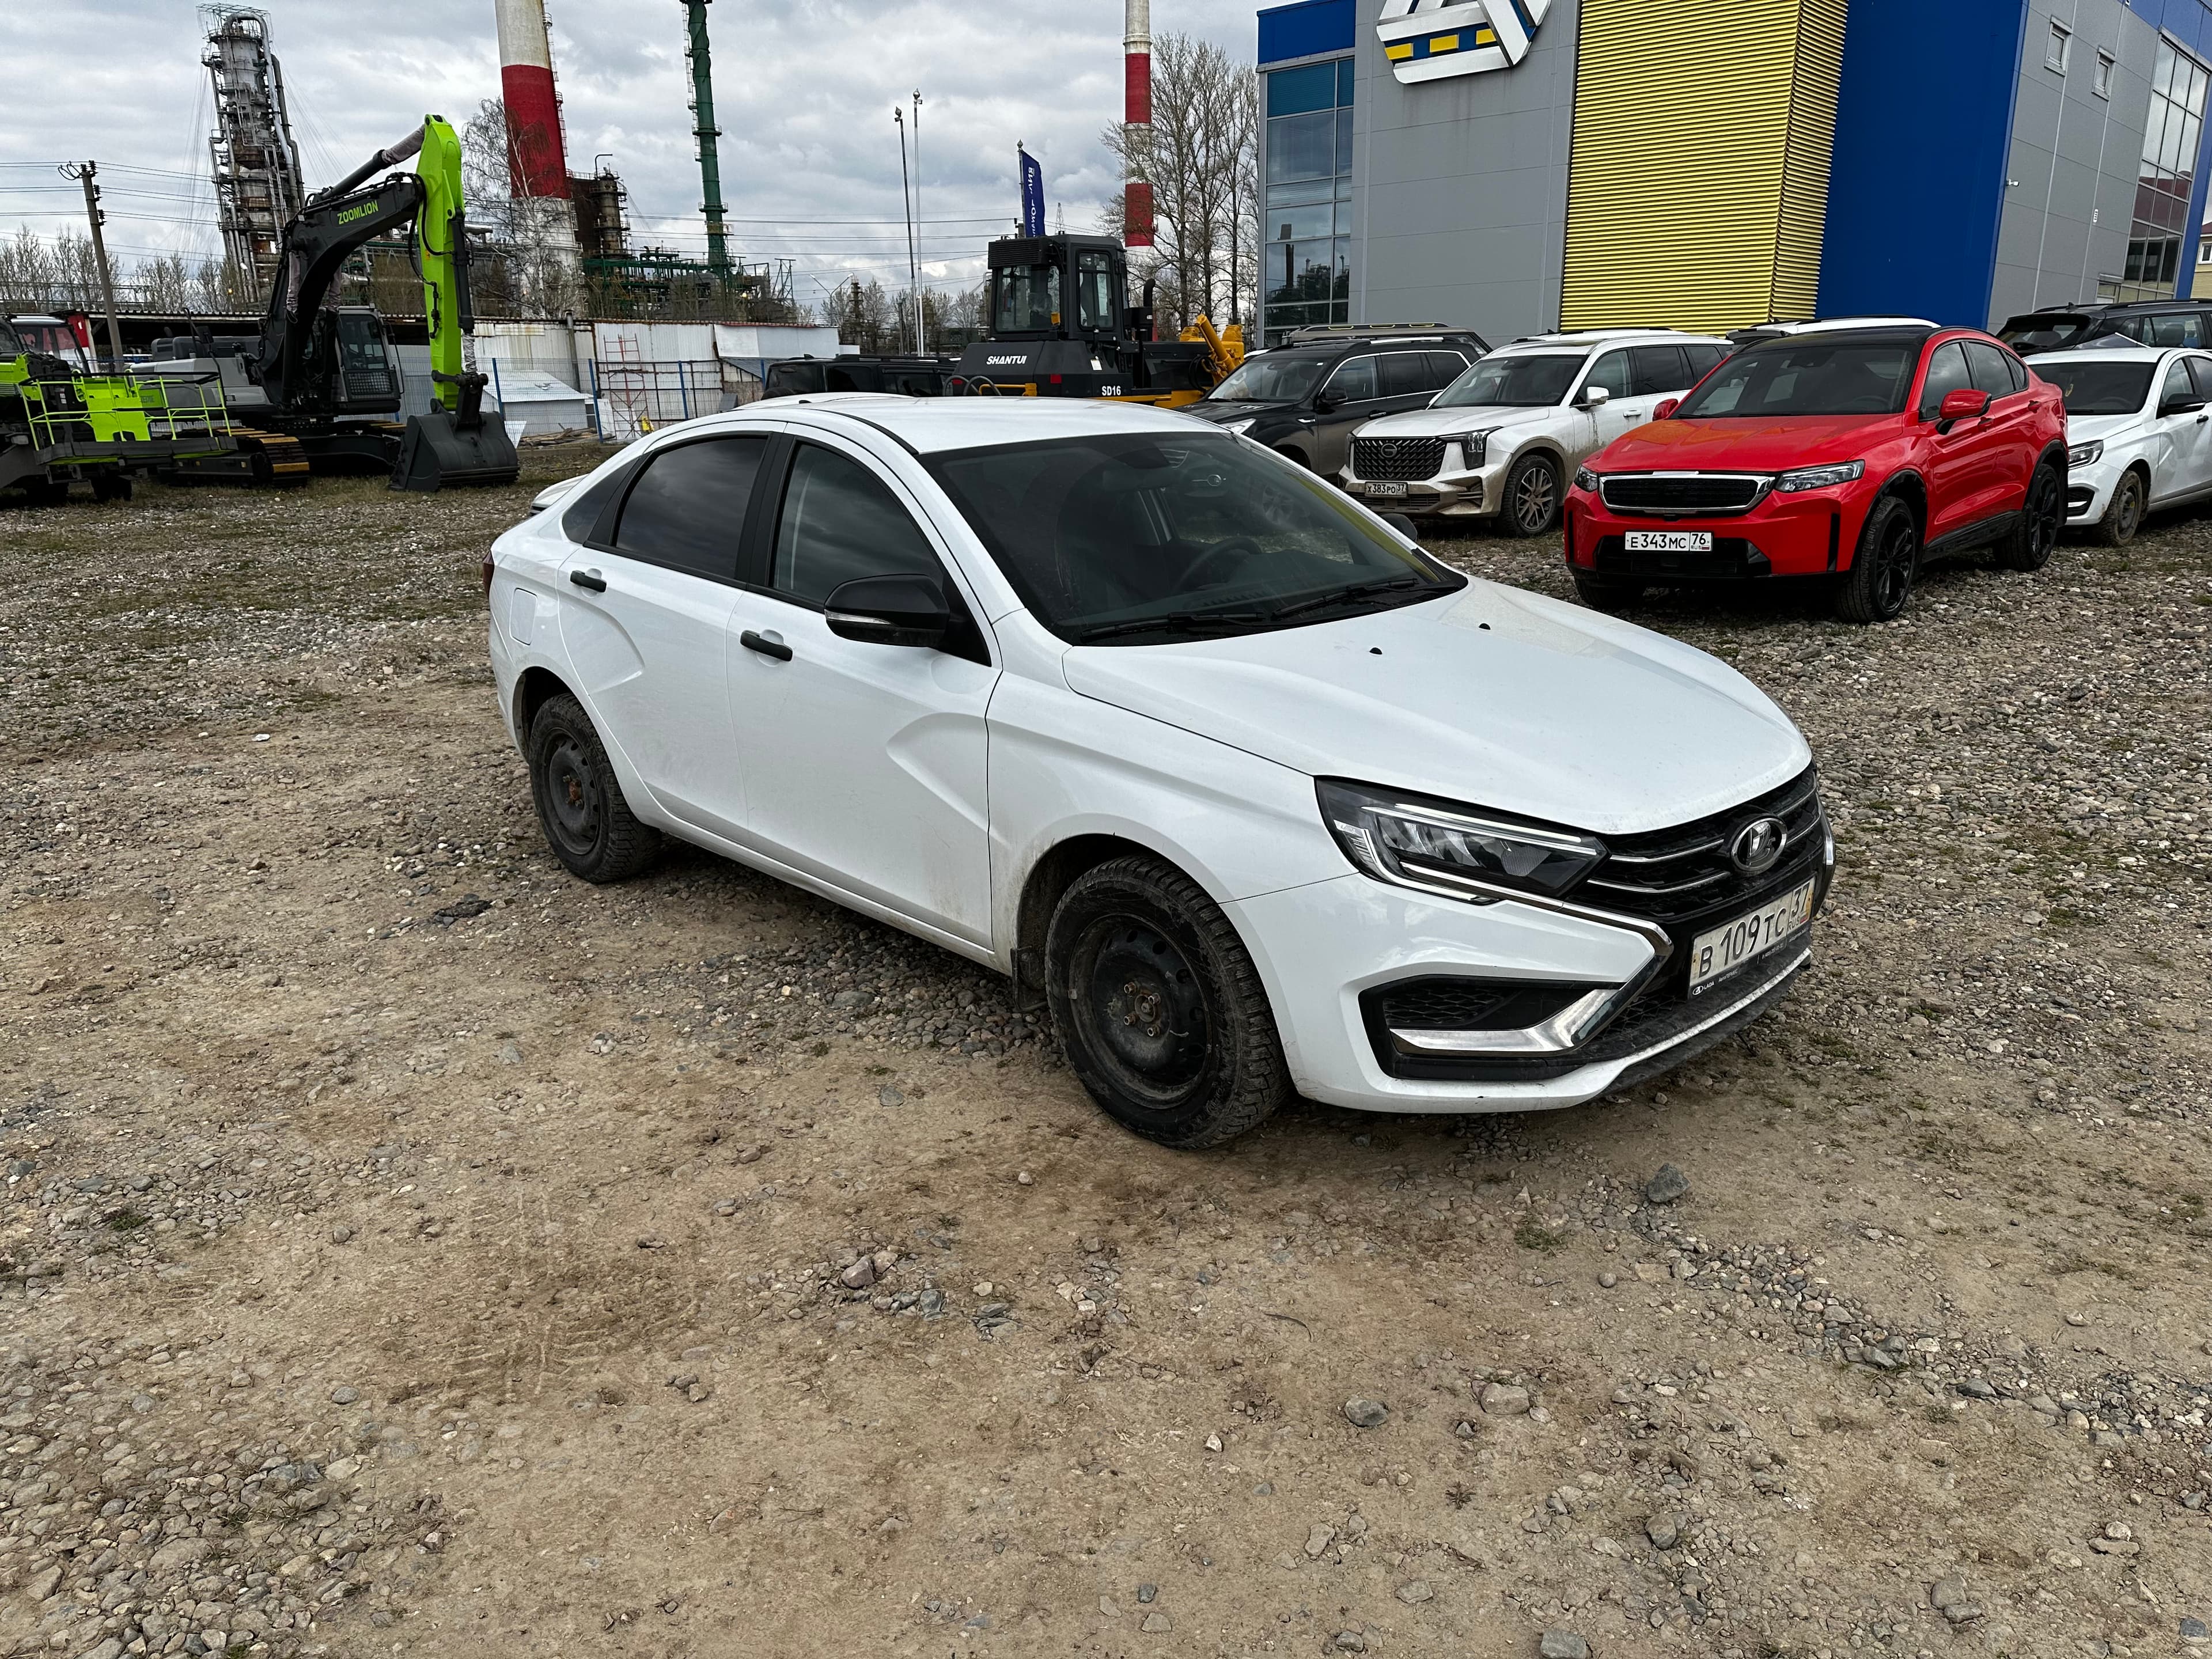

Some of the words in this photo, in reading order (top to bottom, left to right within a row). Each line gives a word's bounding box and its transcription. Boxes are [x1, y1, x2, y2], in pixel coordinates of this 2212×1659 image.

[337, 200, 378, 225] ZOOMLION
[986, 355, 1027, 365] SHANTUI
[1101, 385, 1121, 396] SD16
[1692, 533, 1706, 545] 76
[1792, 882, 1810, 917] 37
[1787, 916, 1800, 932] RUS
[1704, 981, 1714, 990] LADA
